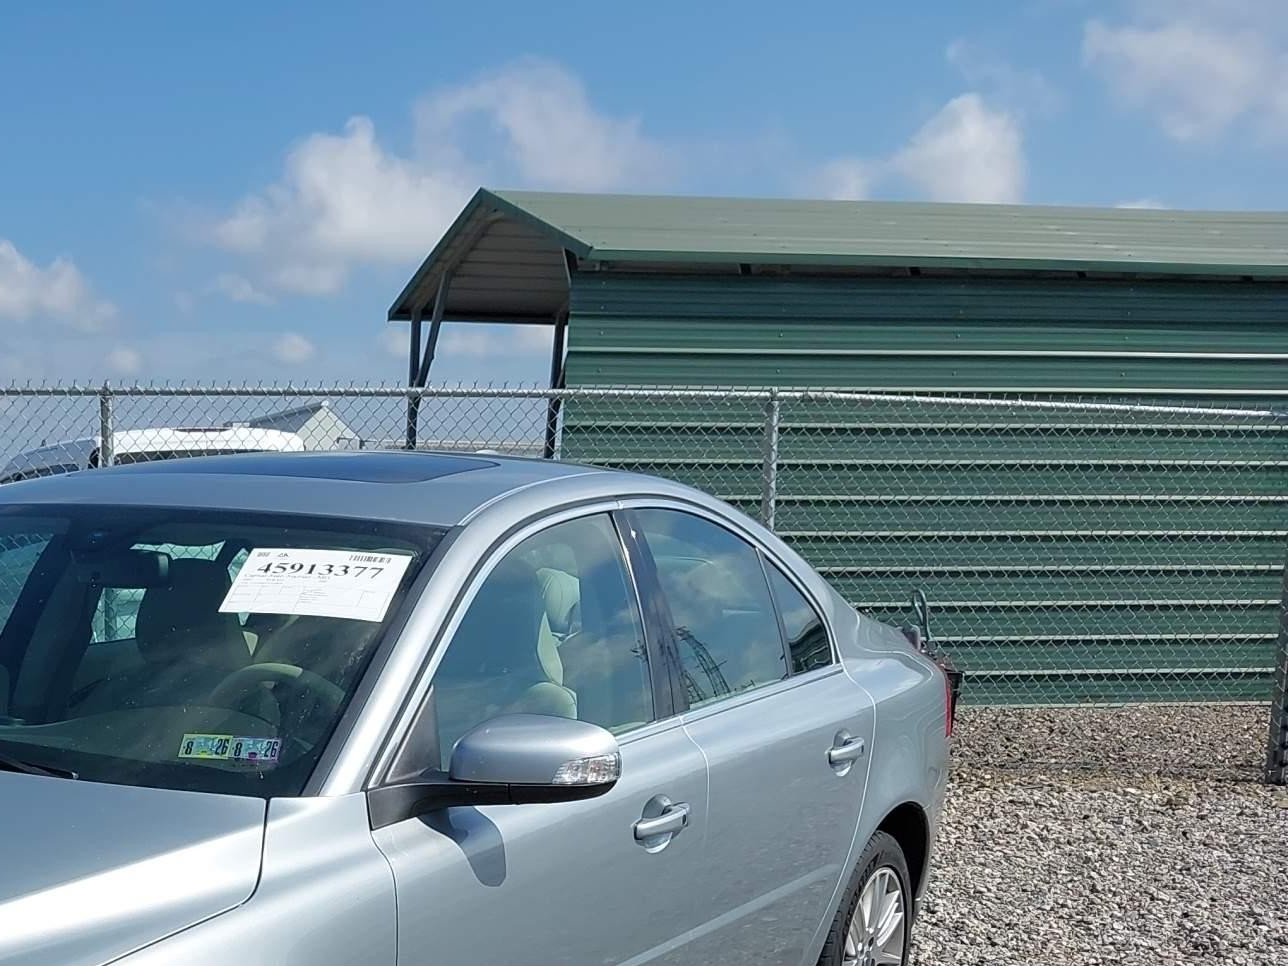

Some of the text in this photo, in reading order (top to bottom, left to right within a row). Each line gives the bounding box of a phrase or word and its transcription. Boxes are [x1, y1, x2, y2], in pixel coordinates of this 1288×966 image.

[257, 562, 384, 580] 45913377
[184, 738, 230, 755] 8 26
[233, 741, 278, 757] 8 26
